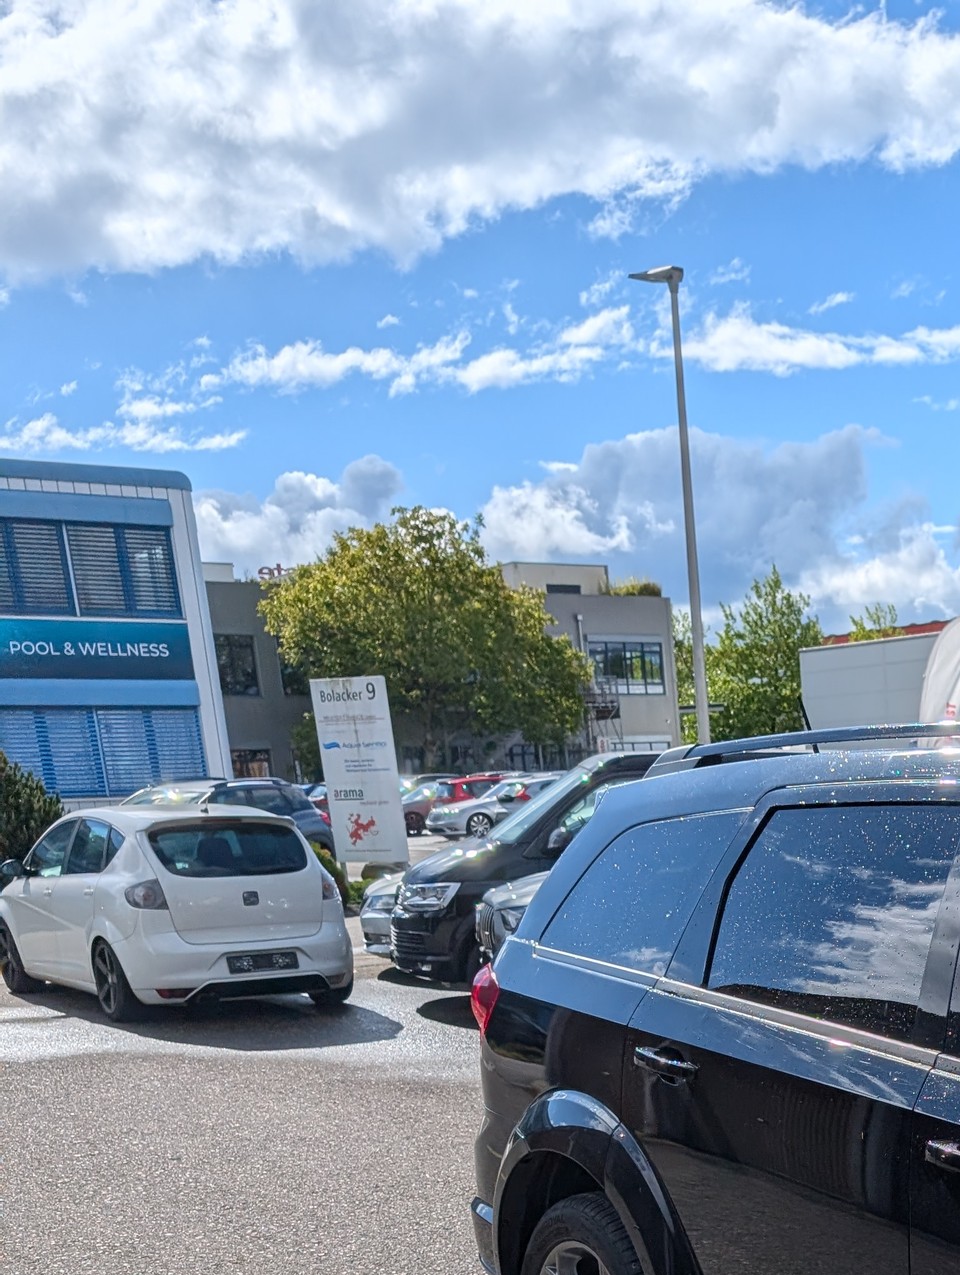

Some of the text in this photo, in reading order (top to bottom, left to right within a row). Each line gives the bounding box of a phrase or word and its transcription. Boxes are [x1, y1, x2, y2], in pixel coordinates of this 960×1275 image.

[9, 640, 170, 658] POOL & WELLNESS
[320, 682, 376, 703] Bolacker 9
[333, 789, 364, 798] arama
